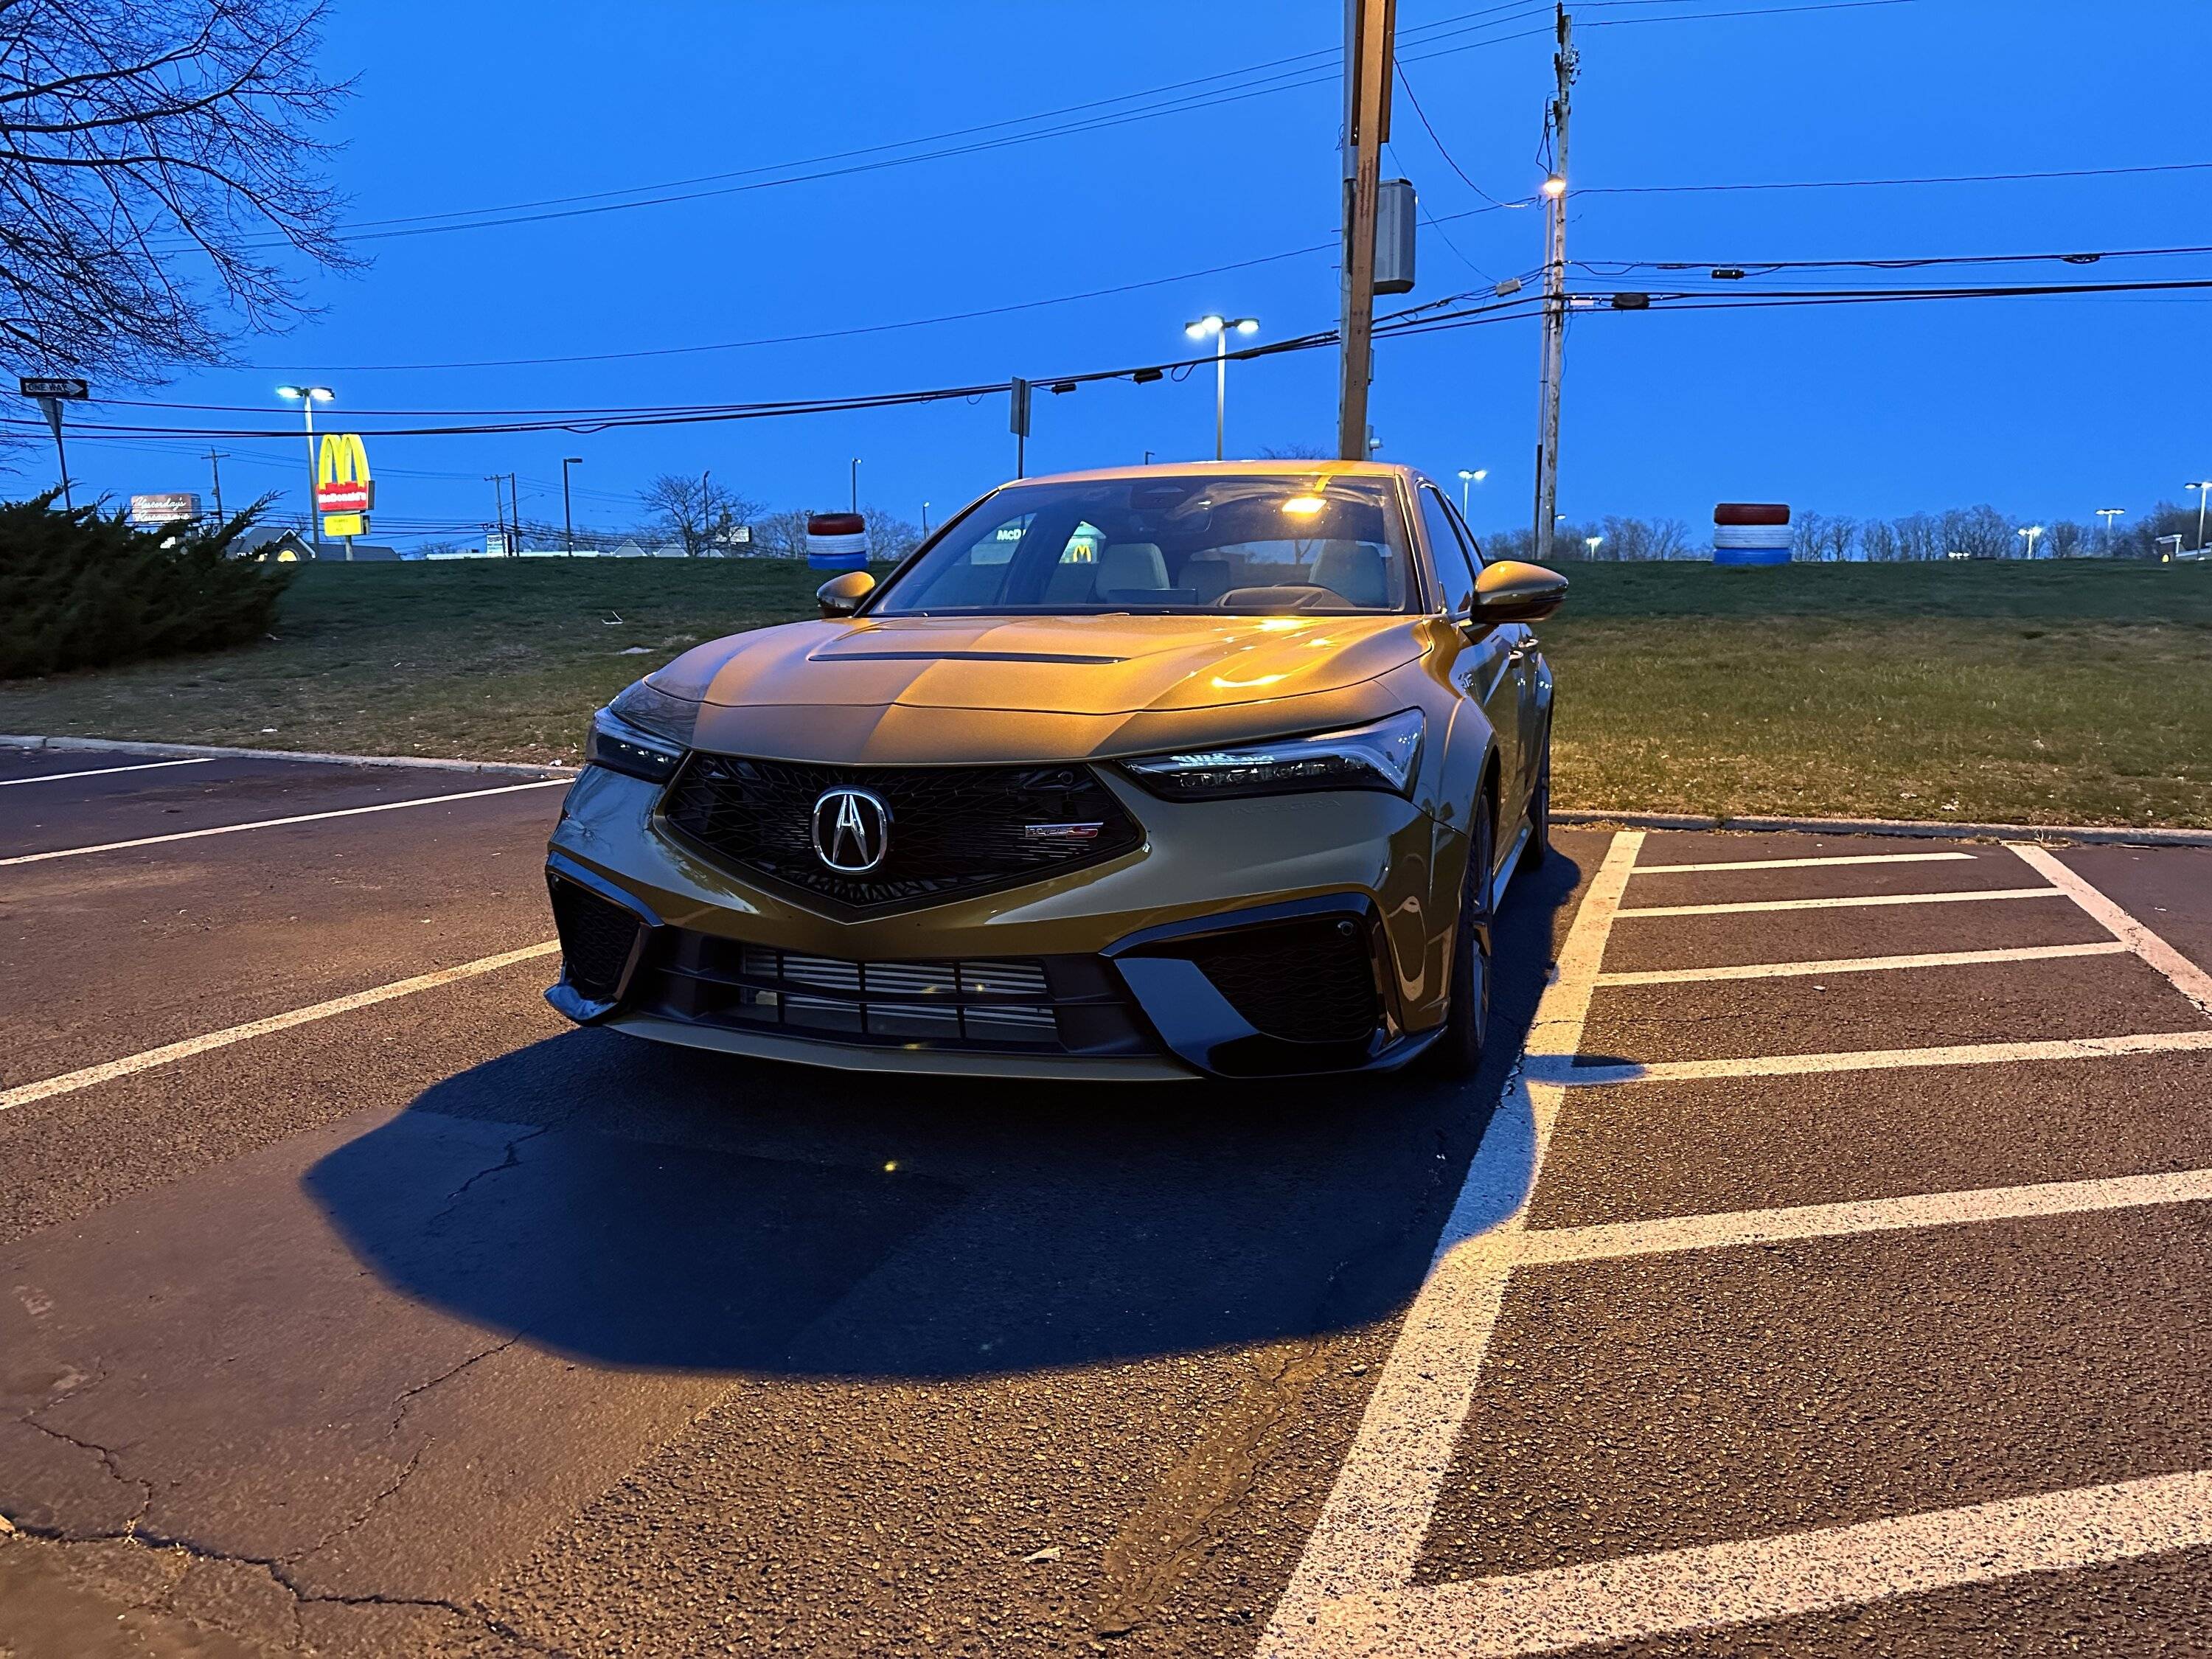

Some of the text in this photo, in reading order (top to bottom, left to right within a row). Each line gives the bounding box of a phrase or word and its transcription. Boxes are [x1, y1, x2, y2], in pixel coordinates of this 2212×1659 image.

[27, 383, 69, 392] ONE WAY
[318, 491, 366, 503] McDonald's
[997, 529, 1026, 540] McD
